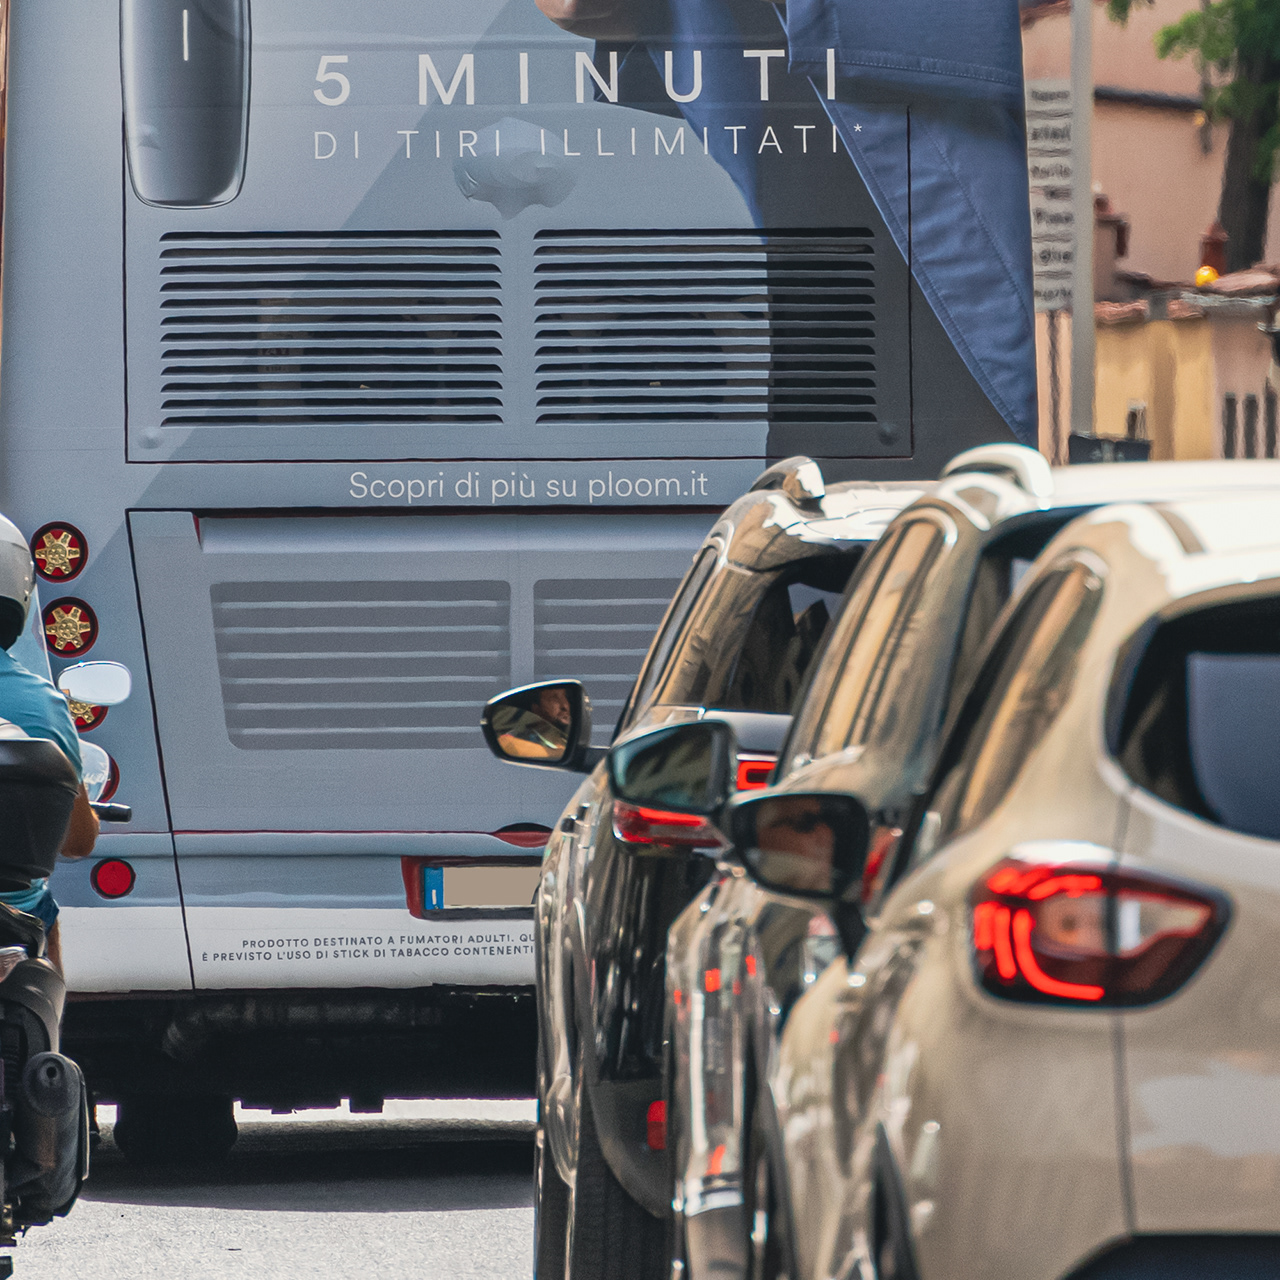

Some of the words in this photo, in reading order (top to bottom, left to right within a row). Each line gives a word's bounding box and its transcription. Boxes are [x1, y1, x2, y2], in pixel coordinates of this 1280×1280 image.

[314, 55, 351, 106] 5
[417, 49, 839, 105] MINUTI
[314, 130, 361, 160] DI
[397, 129, 502, 159] TIRI
[349, 471, 444, 504] Scopri
[453, 470, 480, 499] di
[490, 470, 537, 504] più
[546, 477, 577, 499] su
[588, 469, 709, 504] ploom.it
[202, 952, 208, 961] È
[213, 952, 272, 961] PREVISTO
[277, 950, 311, 960] L'USO
[316, 950, 328, 959] DI
[333, 949, 369, 958] STICK
[374, 949, 386, 957] DI
[390, 947, 449, 957] TABACCO
[454, 945, 534, 956] CONTENENTI
[242, 938, 309, 948] PRODOTTO
[313, 936, 383, 947] DESTINATO
[387, 936, 395, 945] A
[400, 935, 463, 944] FUMATORI
[467, 934, 514, 943] ADULTI.
